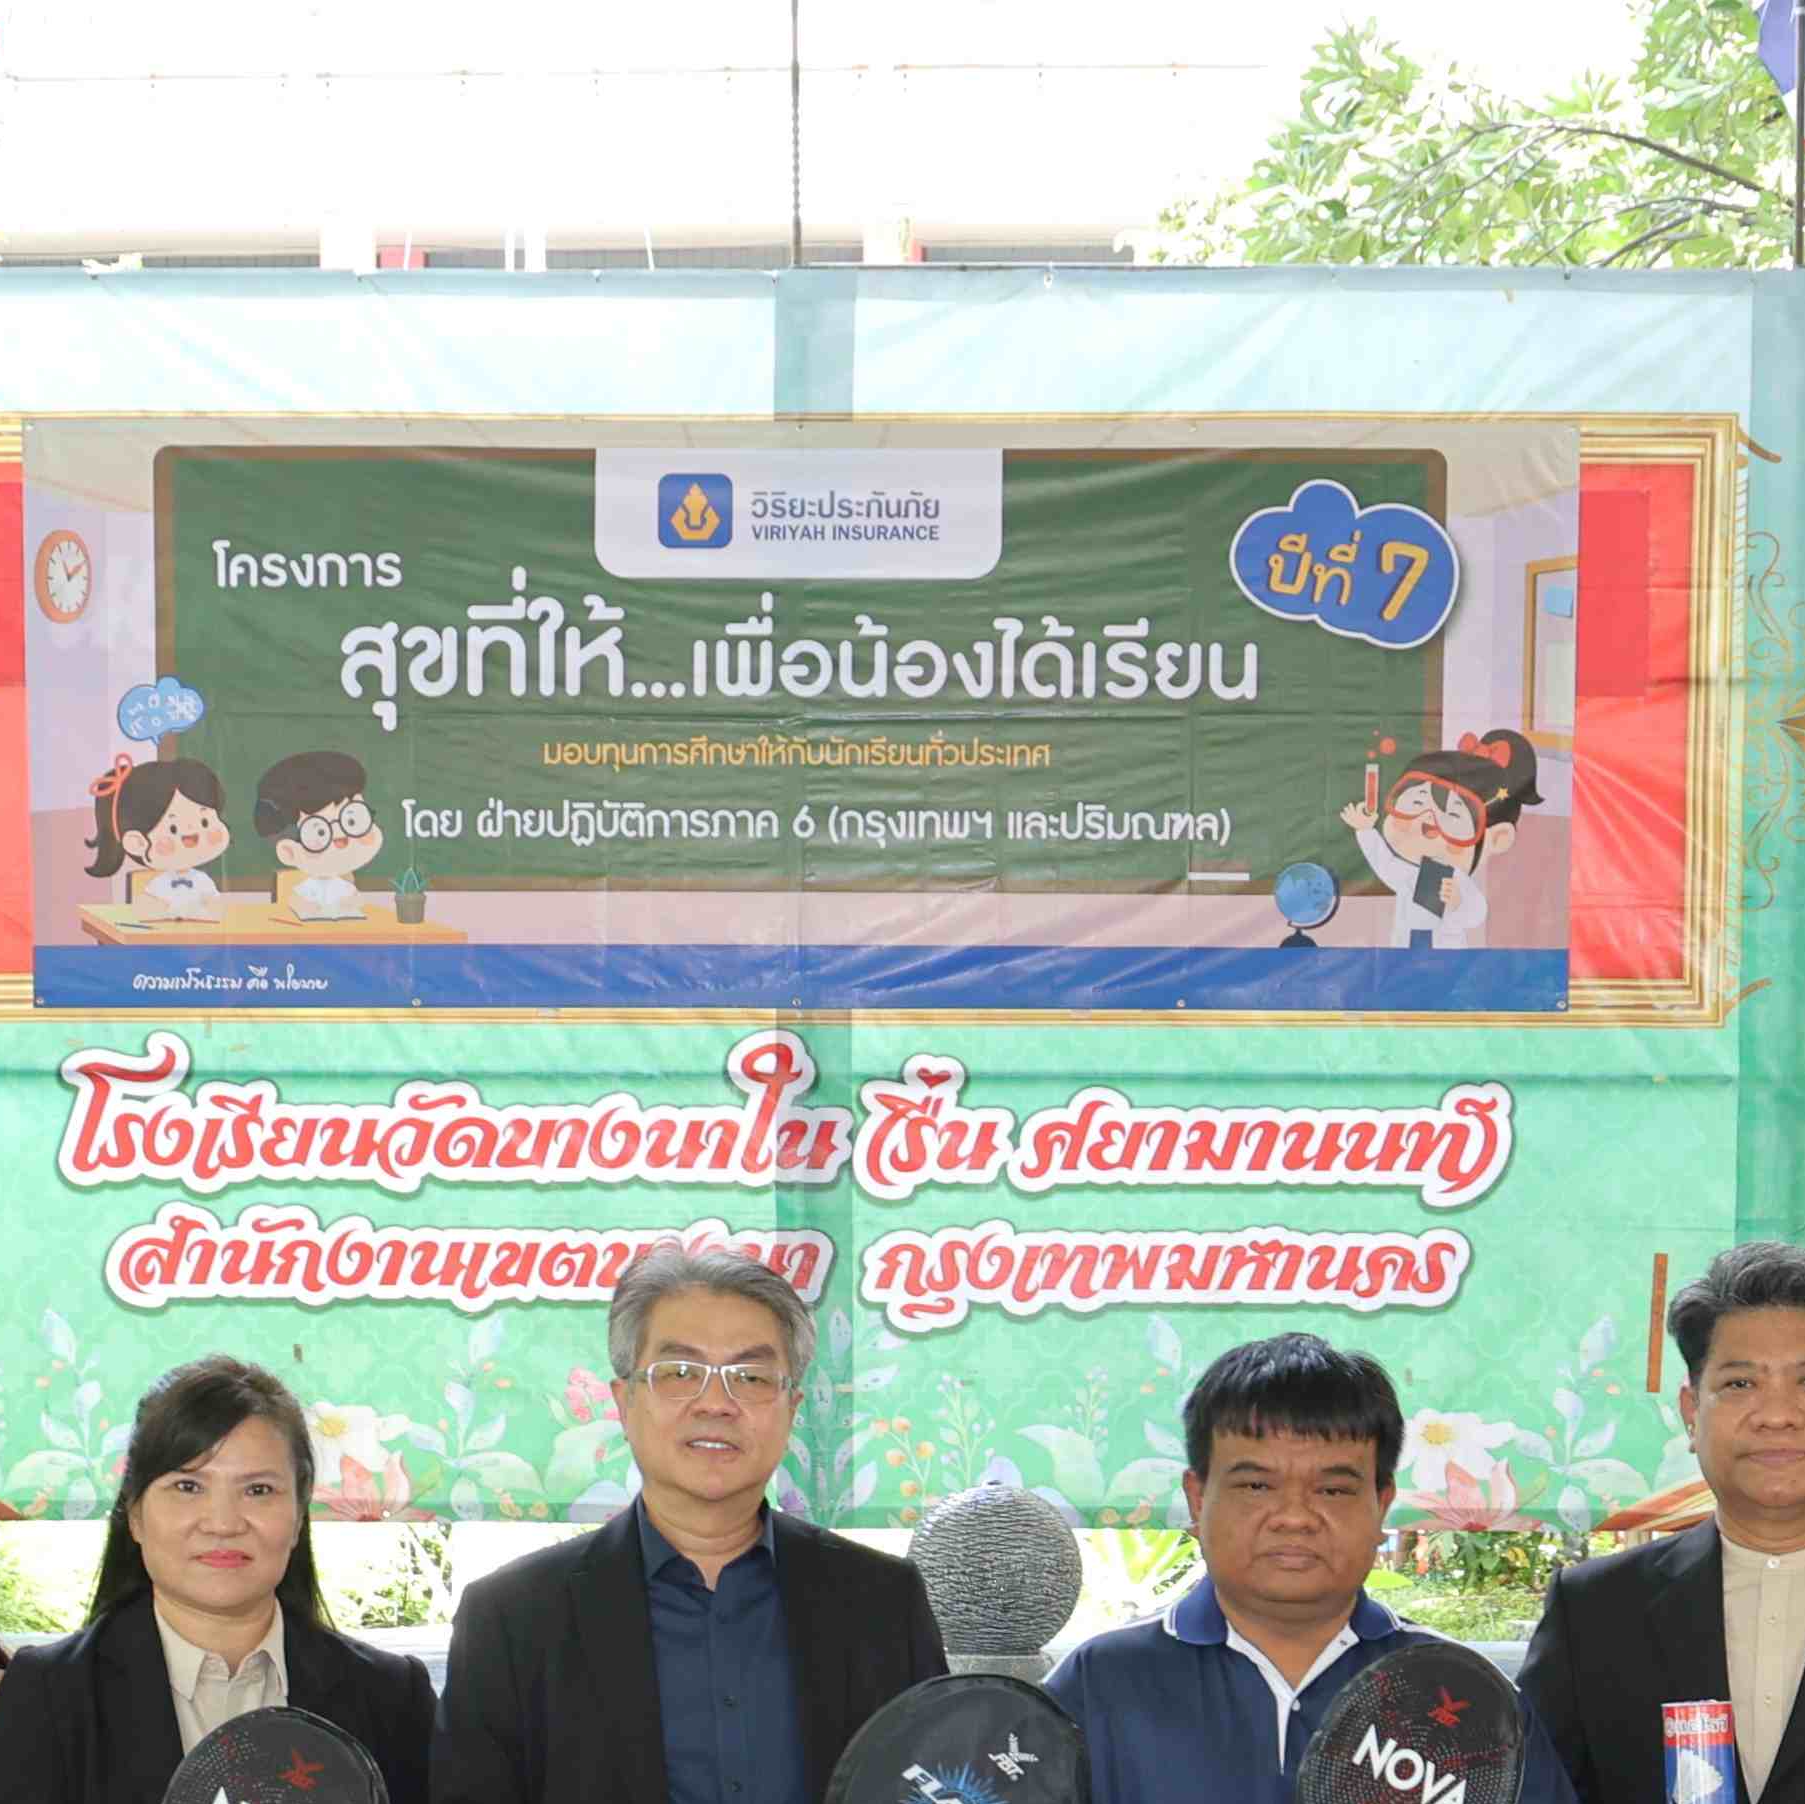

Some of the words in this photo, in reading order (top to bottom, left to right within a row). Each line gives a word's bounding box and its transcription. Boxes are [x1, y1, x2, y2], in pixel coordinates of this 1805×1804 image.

[751, 489, 941, 523] วิริยะประกันภัย
[751, 523, 826, 541] VIRIYAH
[831, 524, 941, 542] INSURANCE
[212, 539, 402, 588] โครงการ
[1266, 530, 1365, 607] ปีที่
[1376, 542, 1430, 623] 7
[340, 567, 1260, 730] สุขที่ให้...เพื่อน้องได้เรียน
[543, 731, 1051, 771] มอบทุนการศึกษาให้กับนักเรียนทั่วประเทศ
[402, 799, 462, 839] โดย
[476, 797, 780, 848] ฝ่ายปฏิบัติการภาค
[792, 811, 817, 839] 6
[826, 803, 994, 852] (กรุงเทพฯ
[1007, 801, 1232, 846] และปริมณฑล)
[246, 965, 268, 991] คือ
[66, 1042, 841, 1180] โรงเรียนวัดบางนาใน
[875, 1232, 1458, 1319] กรุงเทพมหานคร
